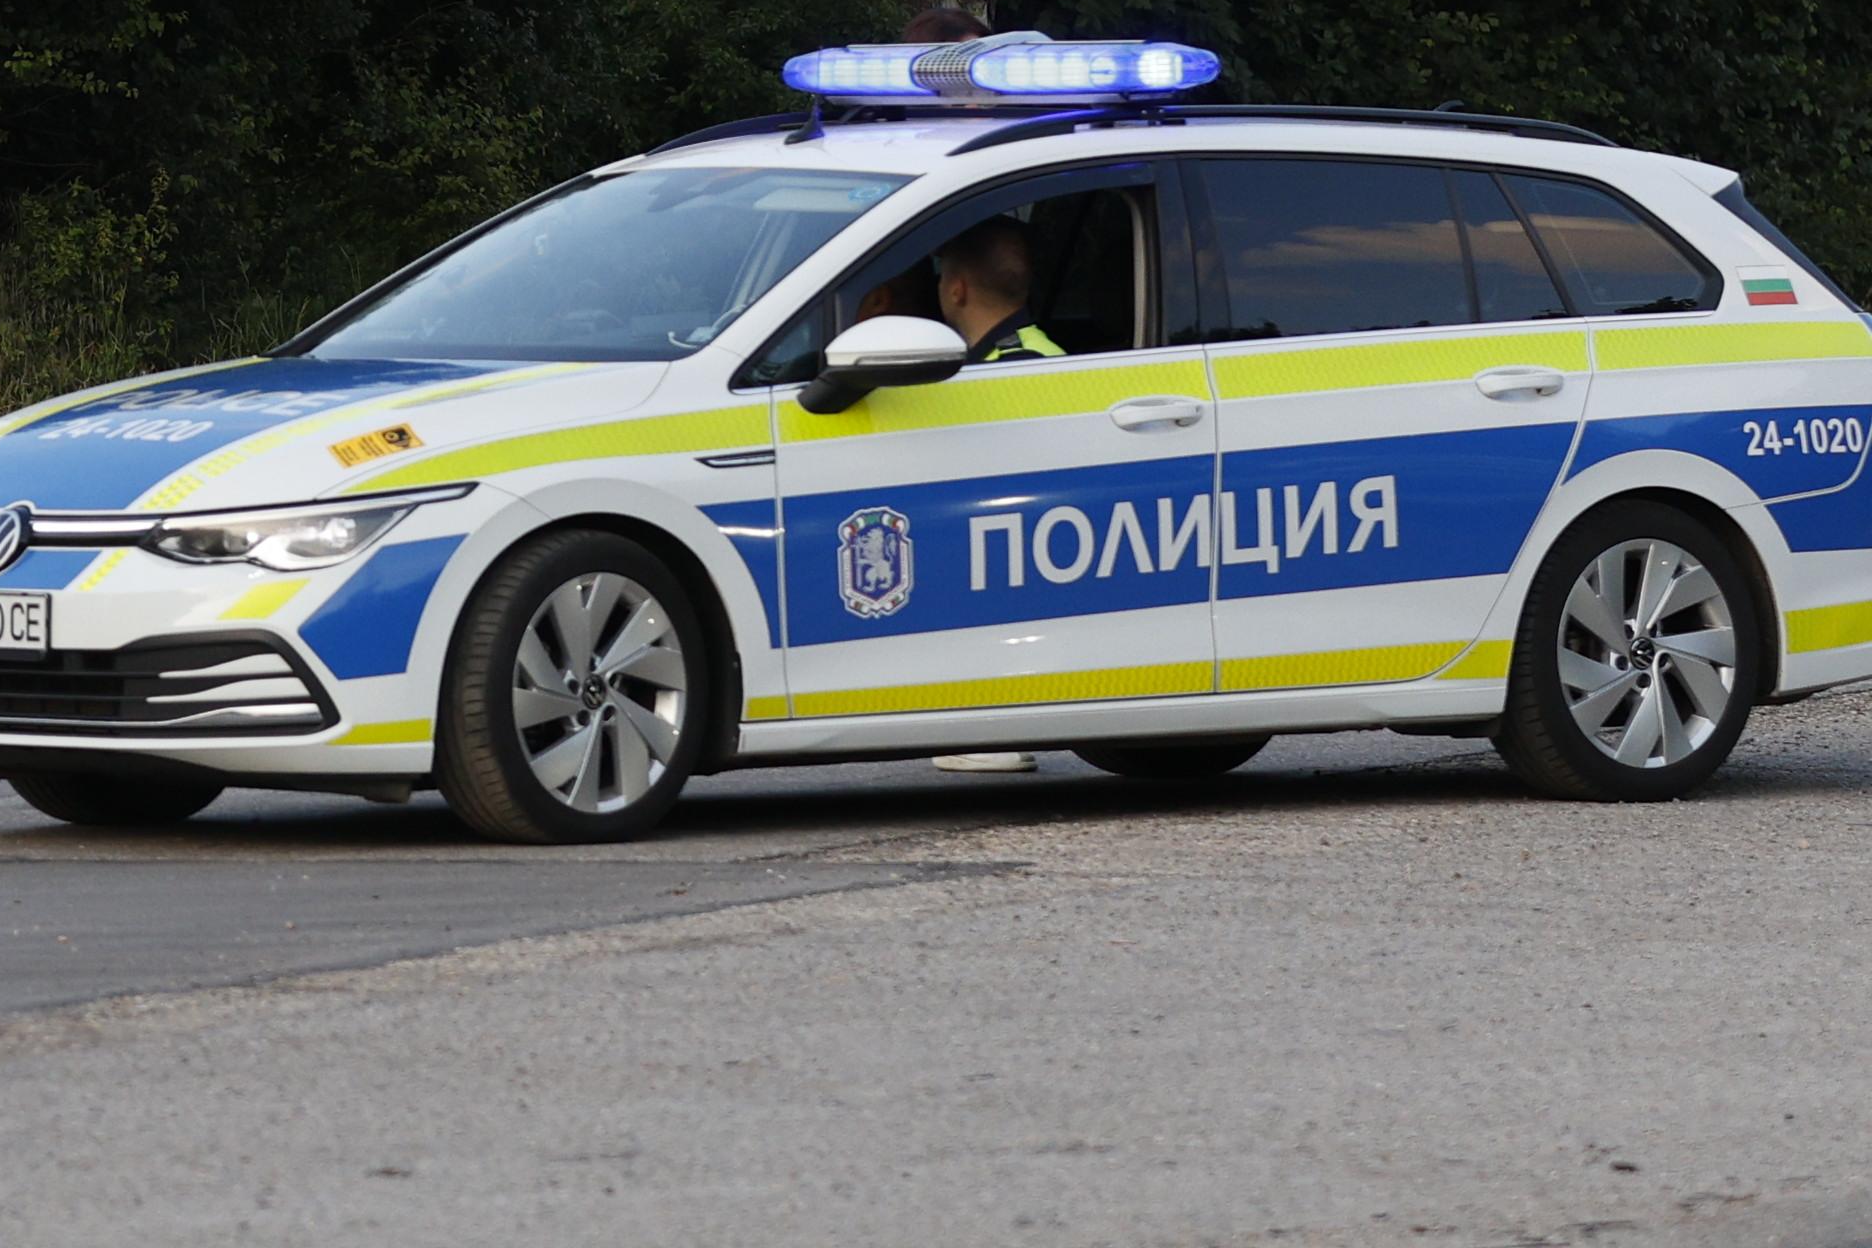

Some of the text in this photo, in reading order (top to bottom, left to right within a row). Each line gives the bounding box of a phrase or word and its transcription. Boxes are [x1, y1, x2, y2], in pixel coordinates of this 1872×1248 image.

[71, 388, 349, 416] POLICE
[38, 417, 215, 443] 24-1020
[1742, 417, 1864, 457] 24-1020
[968, 474, 1399, 592] ПОЛИЦИЯ
[10, 602, 41, 642] CE
